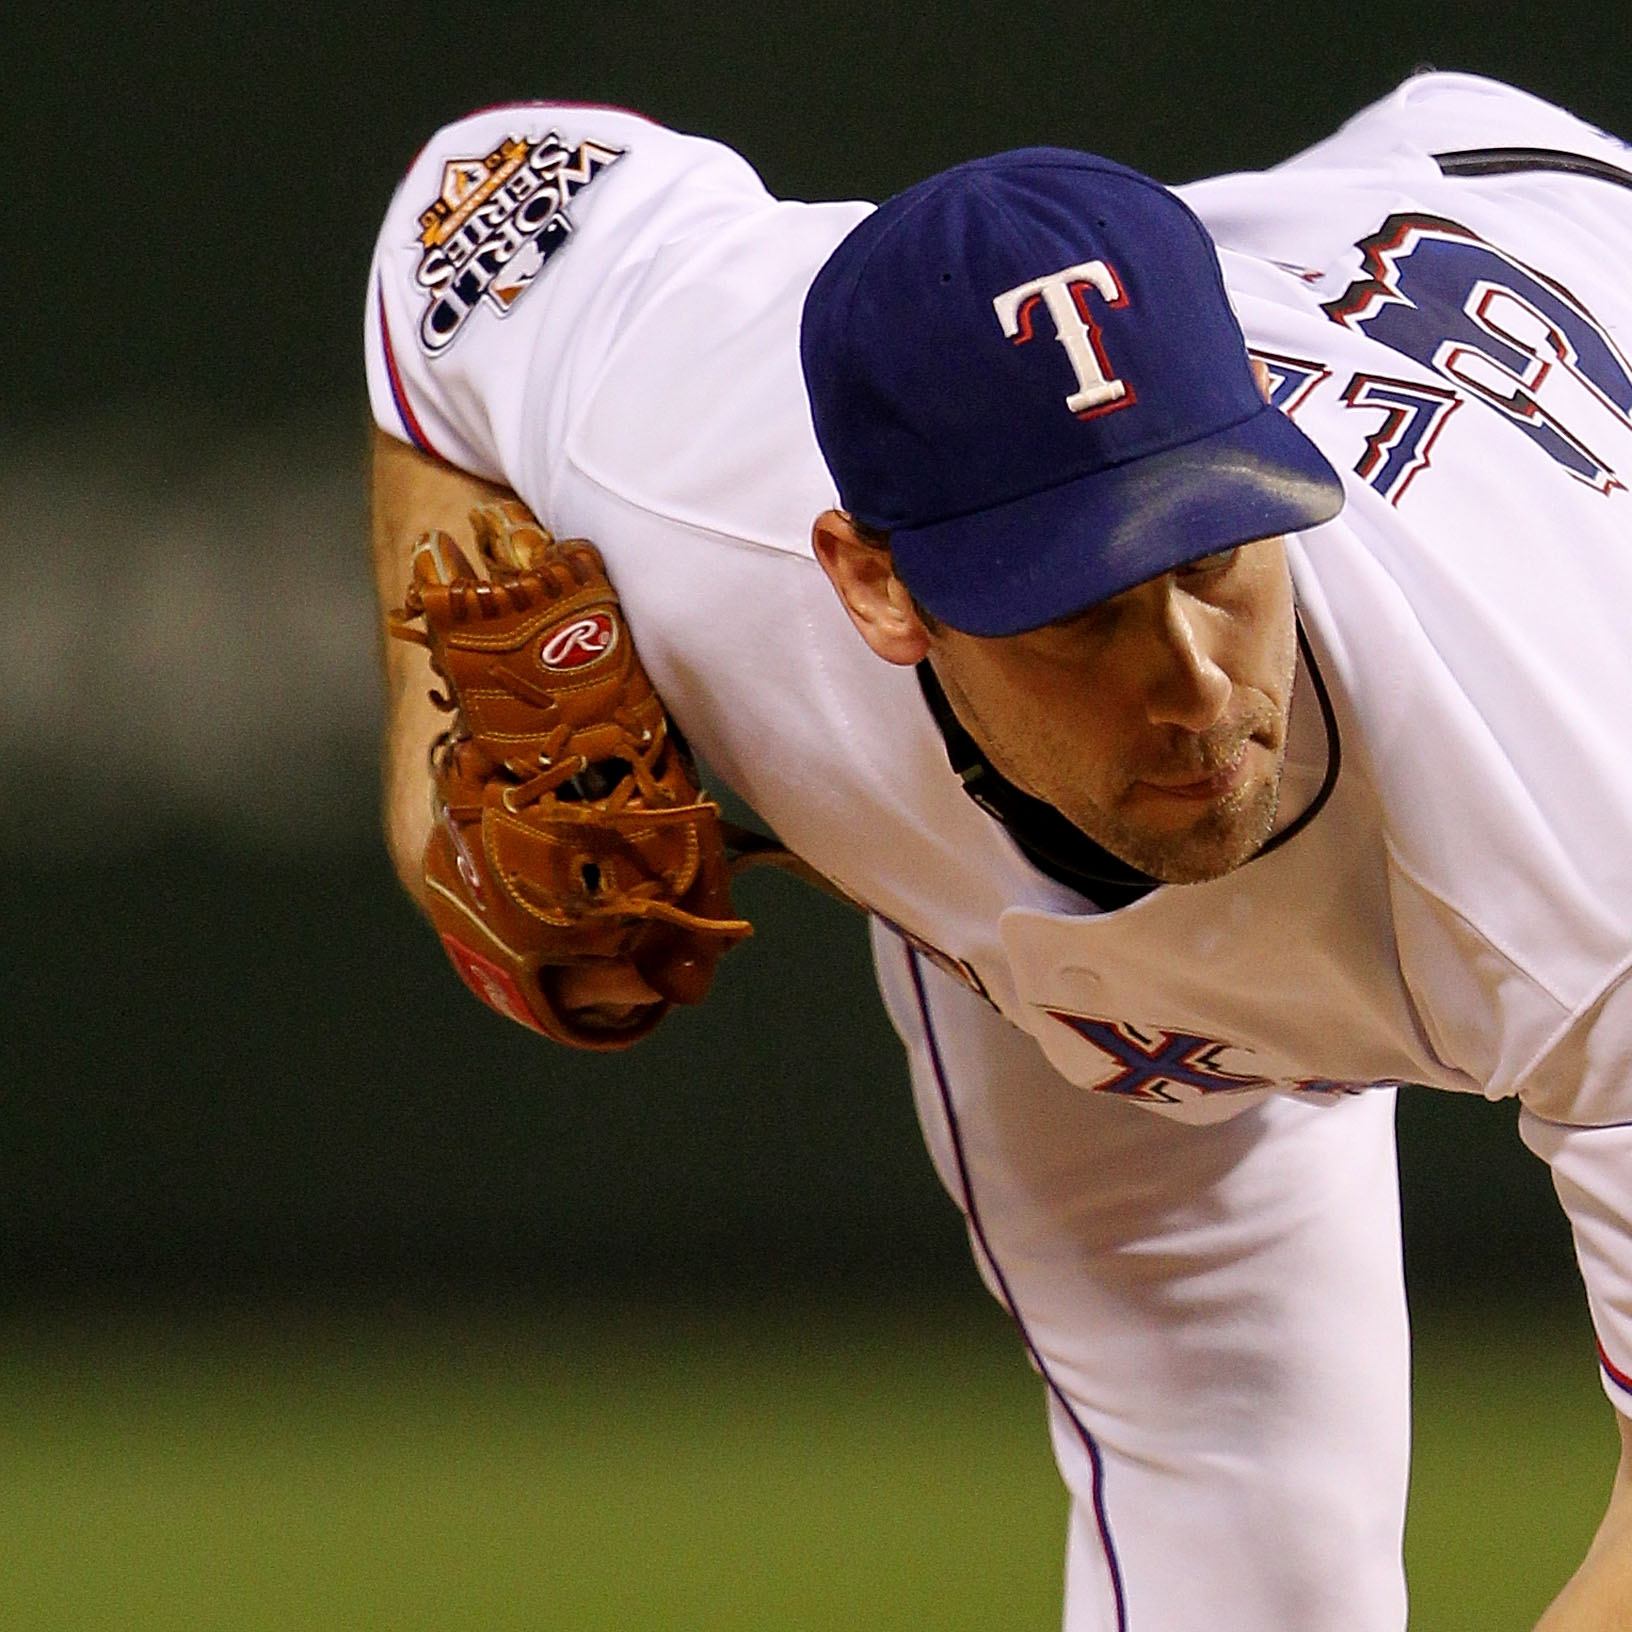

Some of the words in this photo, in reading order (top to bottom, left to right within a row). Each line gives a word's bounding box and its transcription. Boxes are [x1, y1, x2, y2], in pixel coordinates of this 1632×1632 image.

[416, 133, 570, 299] SERIES
[420, 138, 628, 351] WORLD
[992, 259, 1138, 422] T
[542, 620, 604, 664] R
